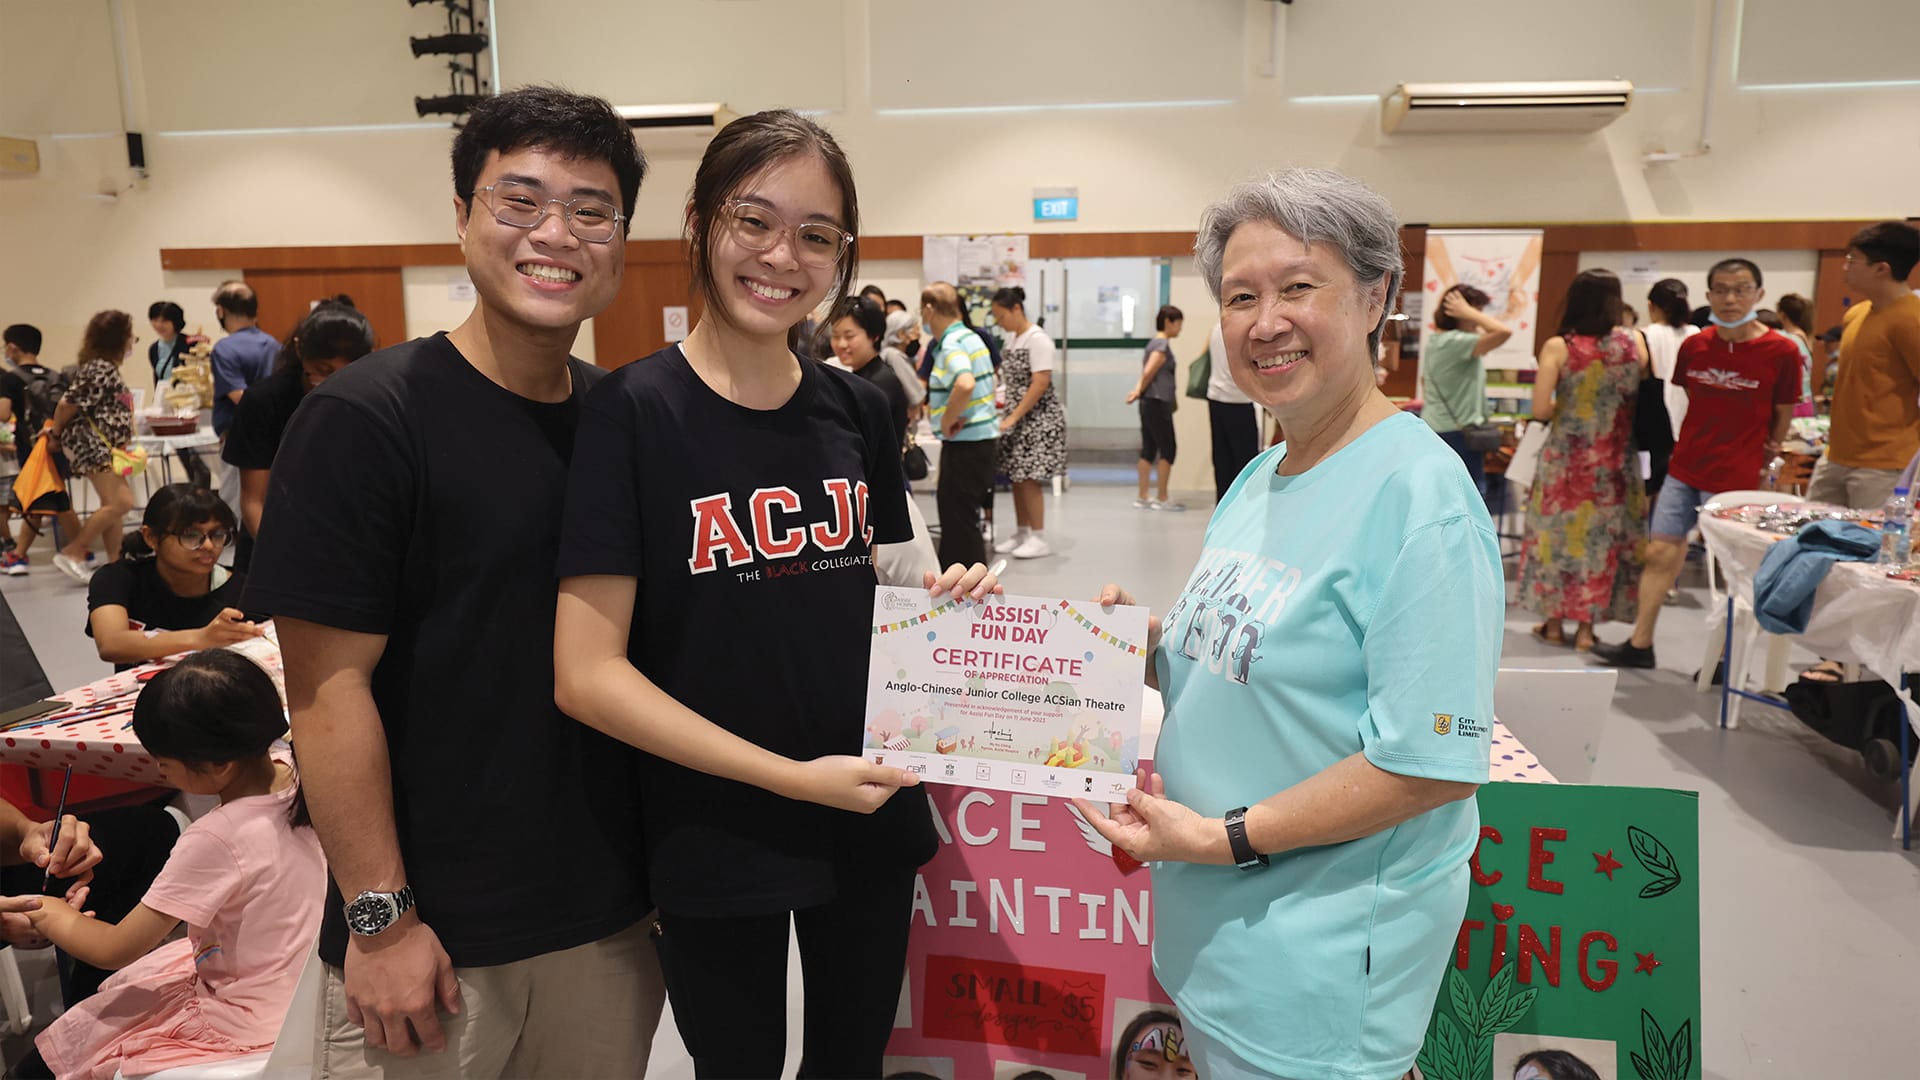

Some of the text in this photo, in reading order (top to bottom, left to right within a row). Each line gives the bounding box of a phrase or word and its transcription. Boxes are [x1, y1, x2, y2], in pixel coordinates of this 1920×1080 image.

[1042, 201, 1068, 216] EXIT
[736, 570, 761, 584] THE
[765, 560, 809, 579] BLACK
[981, 605, 1040, 625] ASSISI
[970, 623, 1049, 644] FUN DAY
[932, 647, 1083, 677] CERTIFICATE
[964, 669, 1049, 686] OF APPRECIATION
[885, 680, 1126, 711] Anglo-Chinese Junior College ACSian Theatre
[945, 973, 1047, 1007] SMALL
[1062, 992, 1096, 1023] $5
